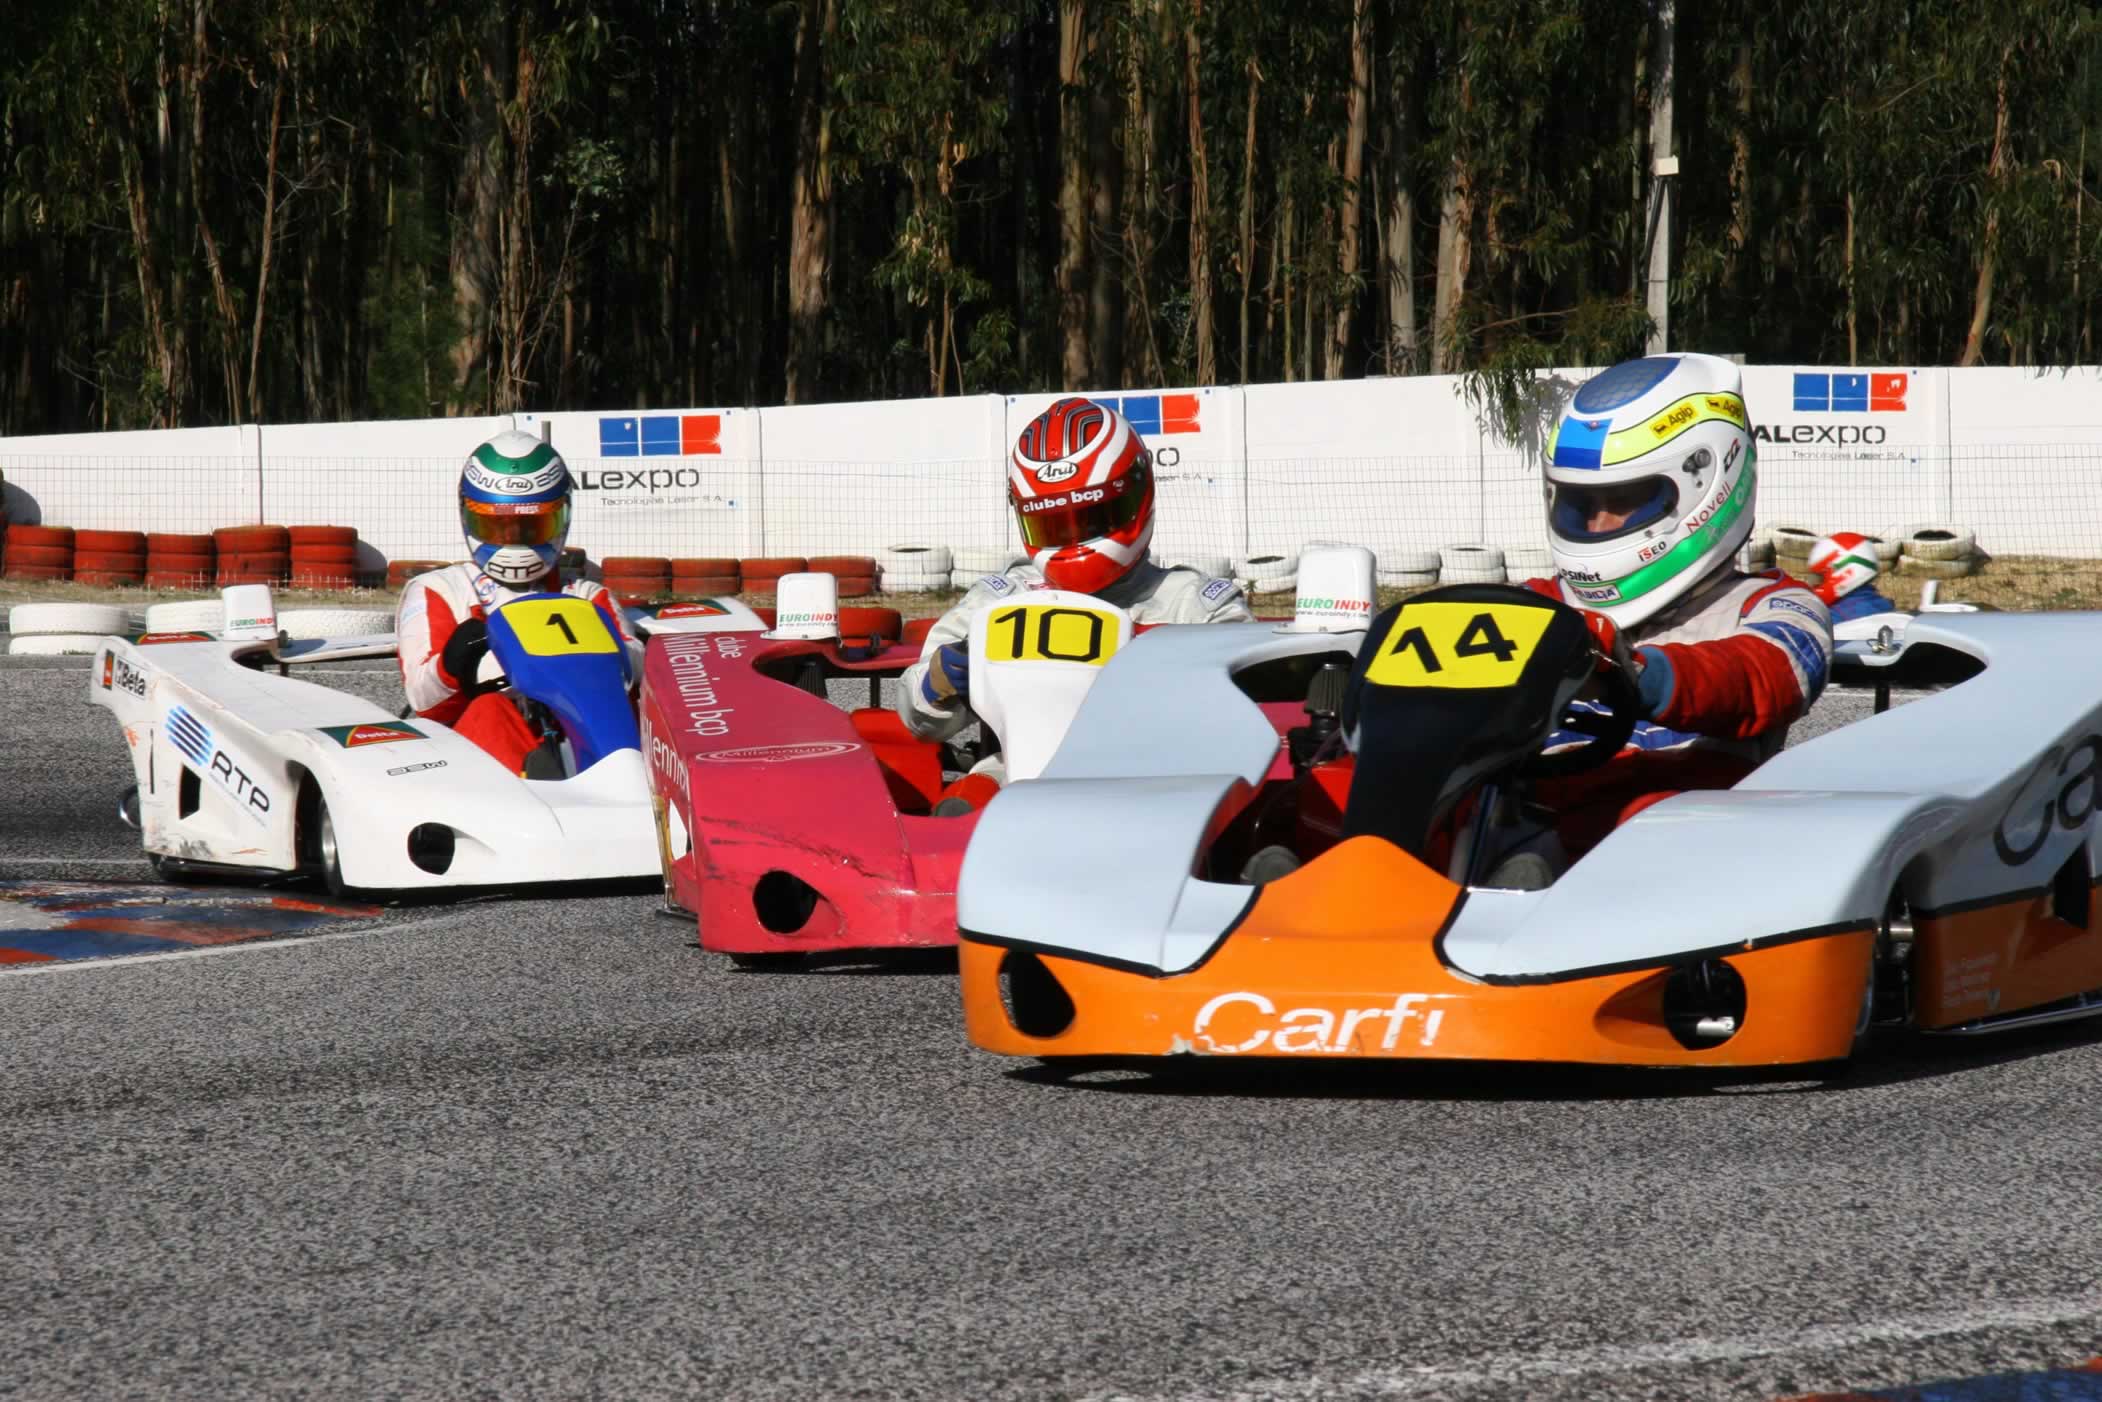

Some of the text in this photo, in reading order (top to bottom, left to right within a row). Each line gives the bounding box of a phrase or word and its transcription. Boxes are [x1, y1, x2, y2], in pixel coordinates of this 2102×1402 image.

[1668, 406, 1694, 427] Agip
[1022, 486, 1104, 513] clube bcp
[1686, 481, 1732, 534] Novell
[1297, 598, 1371, 611] EUROINDY
[546, 613, 579, 644] 1
[995, 608, 1104, 662] 10
[1389, 612, 1518, 673] 14
[121, 662, 146, 697] Beta
[684, 708, 735, 737] bcp
[211, 750, 270, 812] RTP
